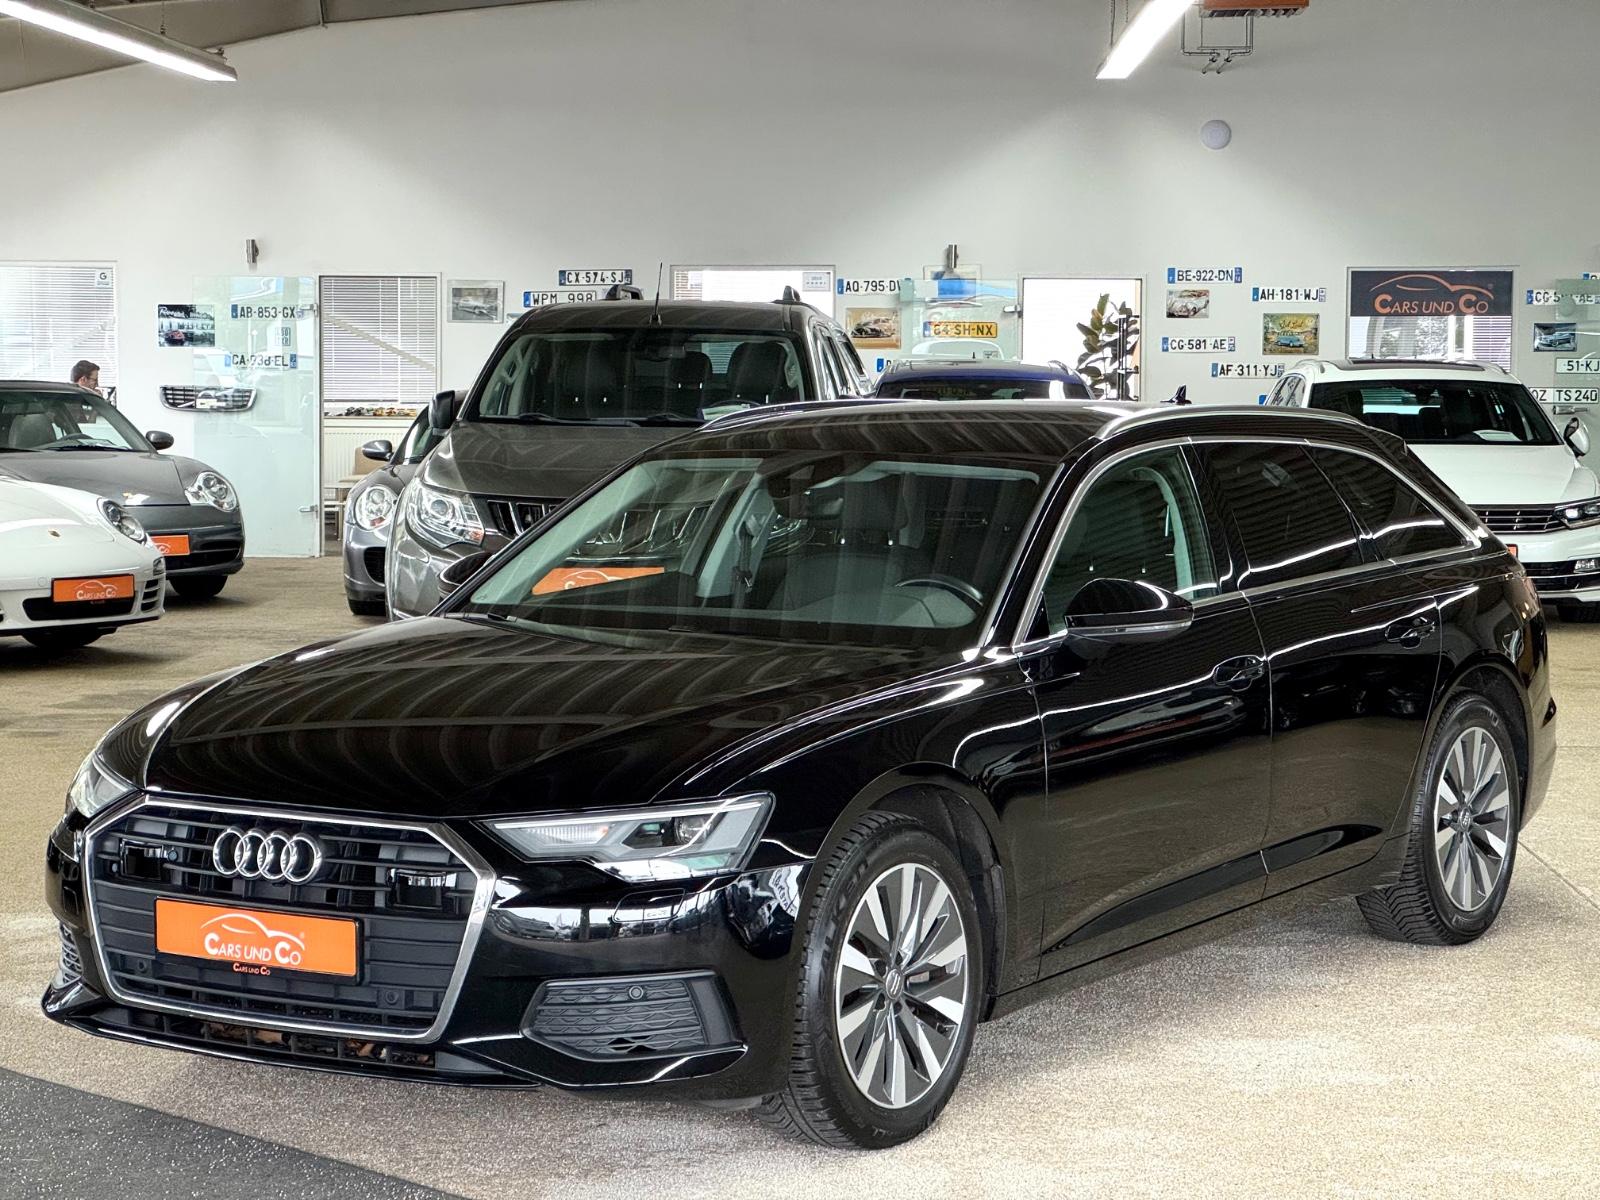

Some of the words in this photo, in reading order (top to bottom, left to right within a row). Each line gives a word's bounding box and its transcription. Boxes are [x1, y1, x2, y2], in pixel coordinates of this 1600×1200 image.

[566, 271, 624, 284] CX-574-SJ
[1177, 269, 1233, 282] BE-922-DN
[532, 293, 558, 306] WPM
[1260, 288, 1319, 301] AH-181-WJ
[1374, 293, 1418, 314] CARS
[1422, 301, 1454, 314] UND
[1458, 293, 1489, 314] CO
[239, 306, 296, 319] AB-853-GX
[1170, 339, 1227, 351] CG-581-AE
[1219, 364, 1278, 377] AF-311-YJ
[1555, 389, 1572, 401] TS
[1574, 389, 1598, 401] 240
[204, 932, 241, 958] CARS
[243, 946, 272, 962] UND
[275, 941, 301, 966] CO
